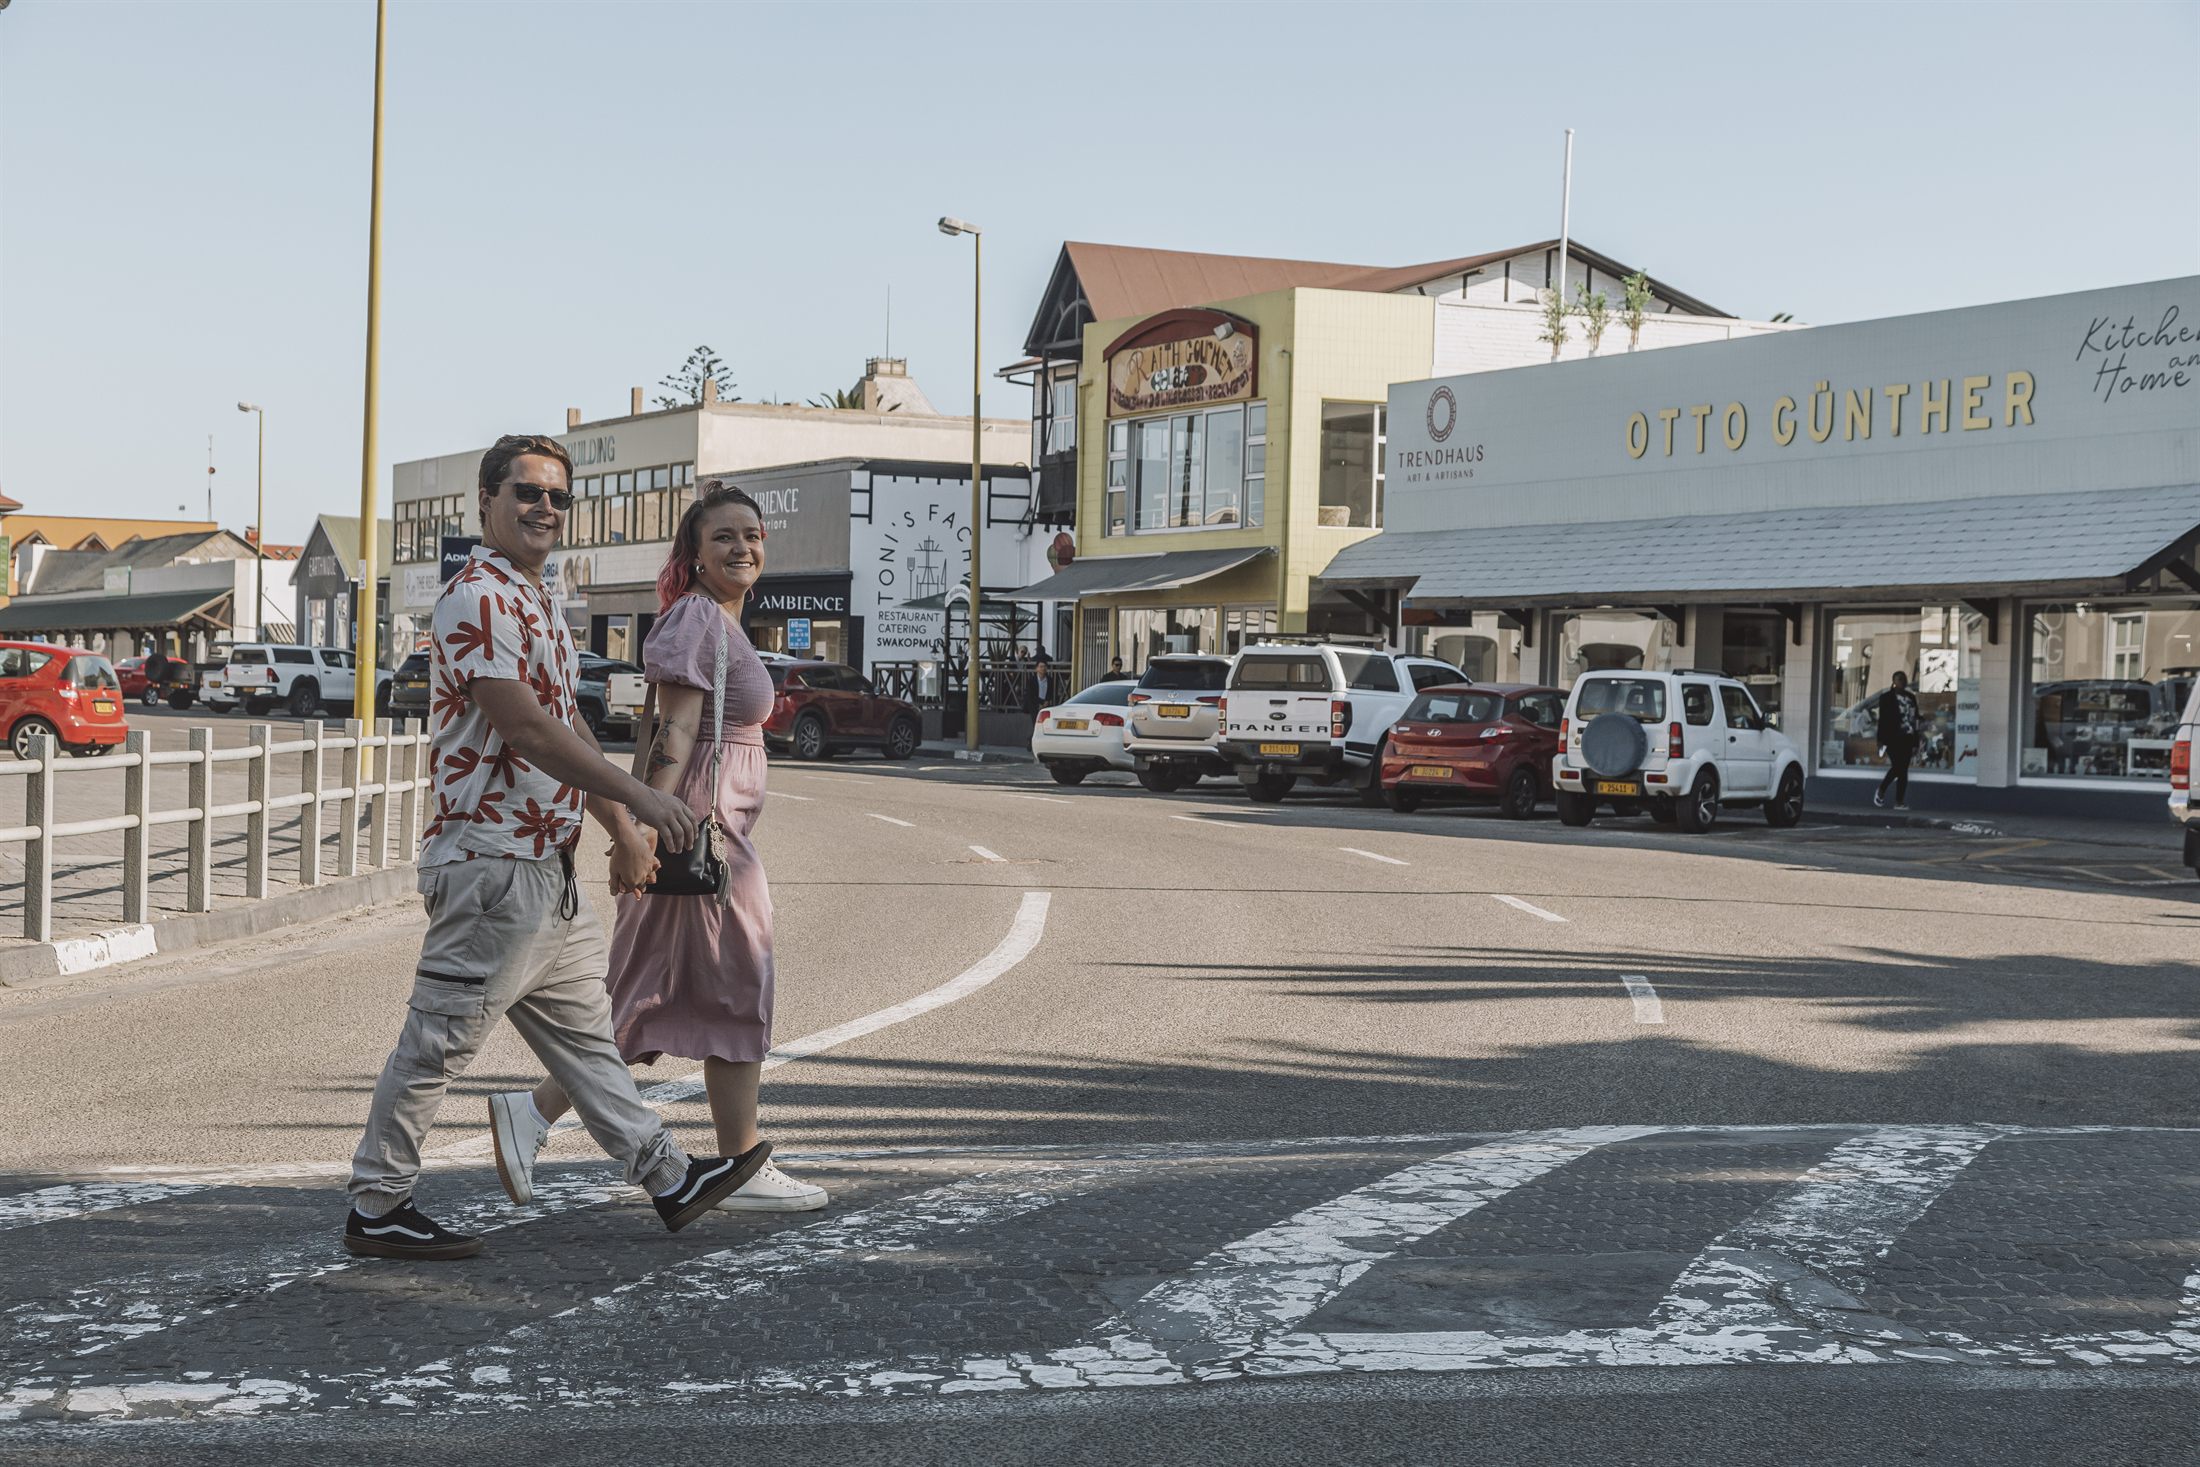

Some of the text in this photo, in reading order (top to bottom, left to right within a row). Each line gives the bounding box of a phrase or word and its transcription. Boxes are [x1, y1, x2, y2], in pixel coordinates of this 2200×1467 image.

[2076, 305, 2200, 361] Kitche
[2169, 354, 2200, 369] an
[2094, 352, 2191, 403] Home
[1626, 371, 2036, 459] OTTO GÜNTHER
[1398, 444, 1484, 468] TRENDHAUS
[1407, 472, 1421, 483] ART
[1435, 468, 1474, 480] ARTISANS
[748, 488, 799, 514] BIENCE
[444, 553, 469, 562] ADM
[759, 595, 844, 611] AMBIENCE
[878, 611, 940, 622] RESTAURANT
[877, 624, 926, 635] CATERING
[876, 638, 945, 648] SWAKOPMUN
[1229, 723, 1329, 734] RANGER
